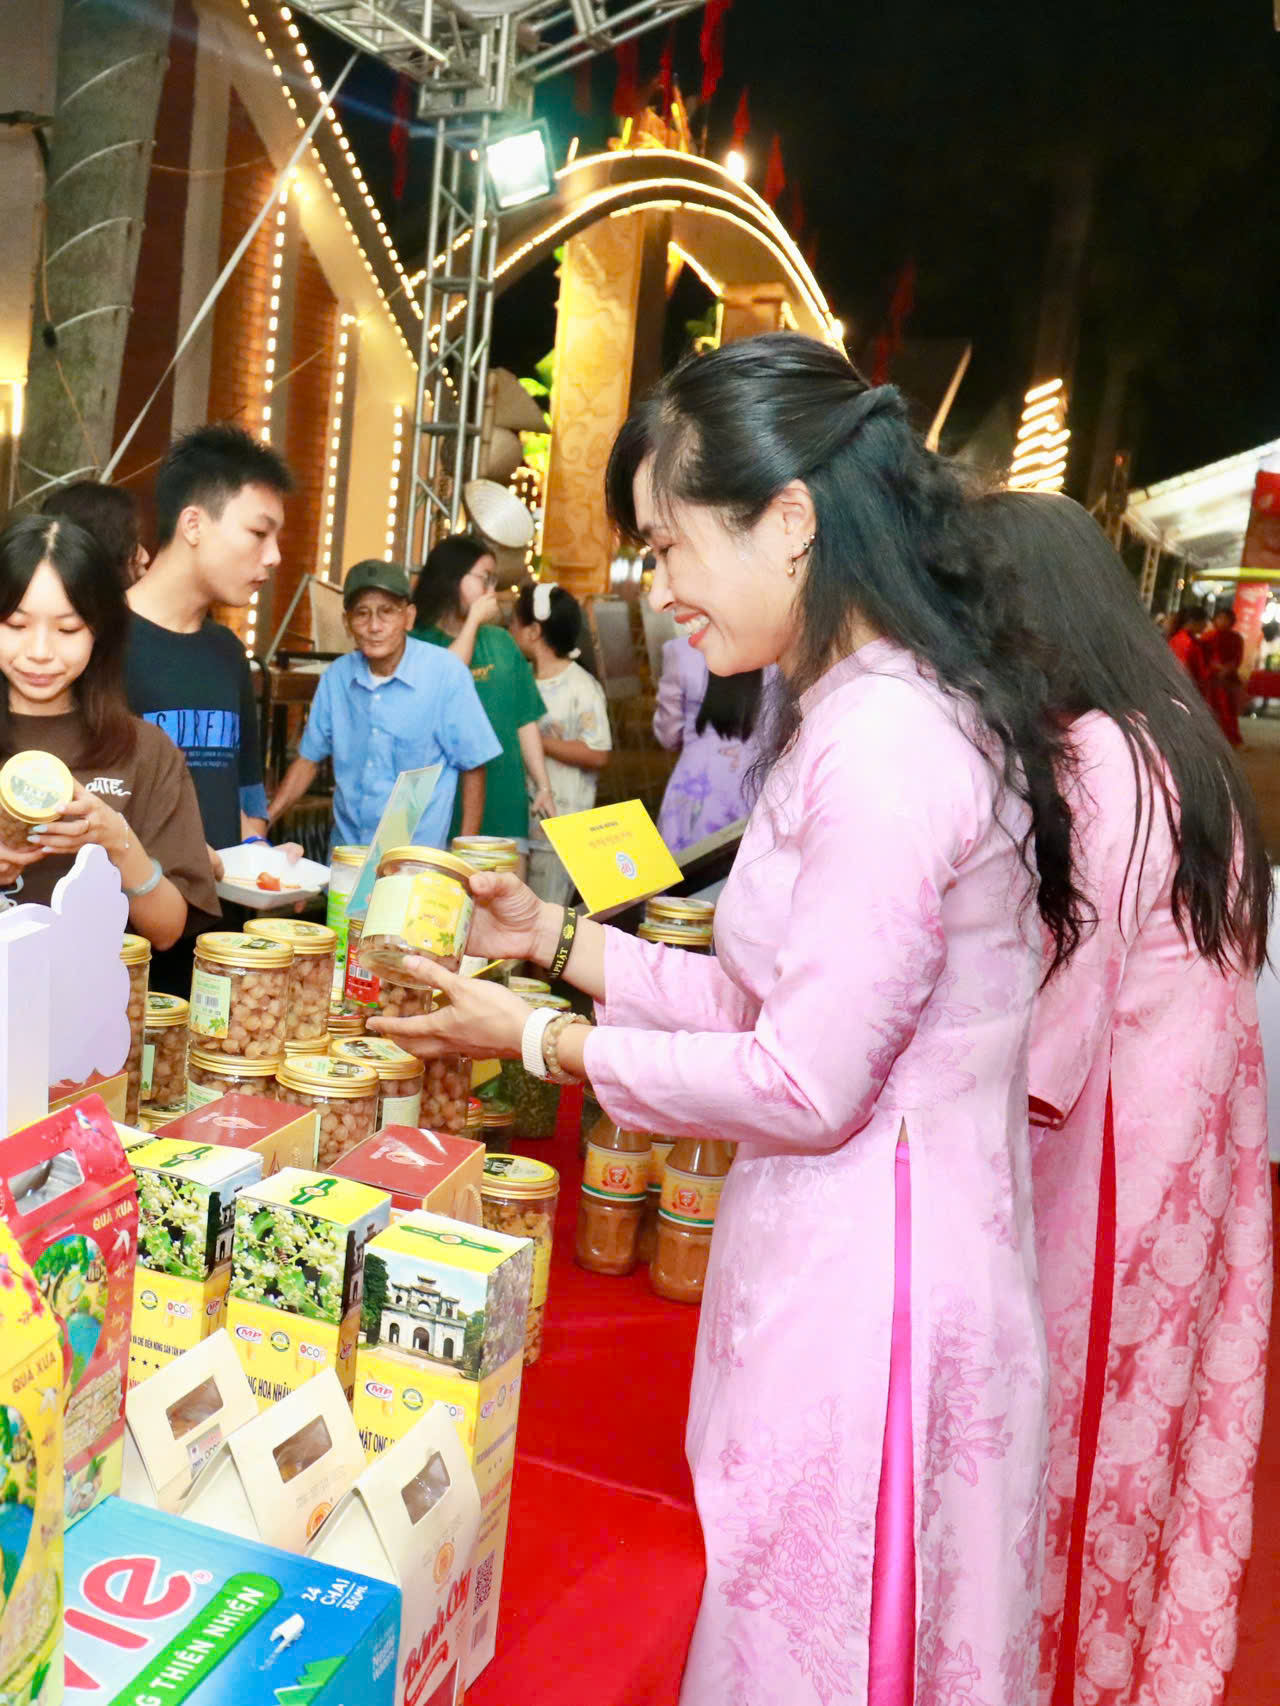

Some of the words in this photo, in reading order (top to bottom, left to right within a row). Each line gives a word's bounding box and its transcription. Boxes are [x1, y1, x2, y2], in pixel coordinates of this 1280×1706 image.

[371, 1384, 392, 1396] MP
[301, 1586, 322, 1602] 24
[320, 1577, 351, 1606] CHAI
[149, 1638, 216, 1689] THIÊN
[202, 1585, 265, 1639] NHIÊN
